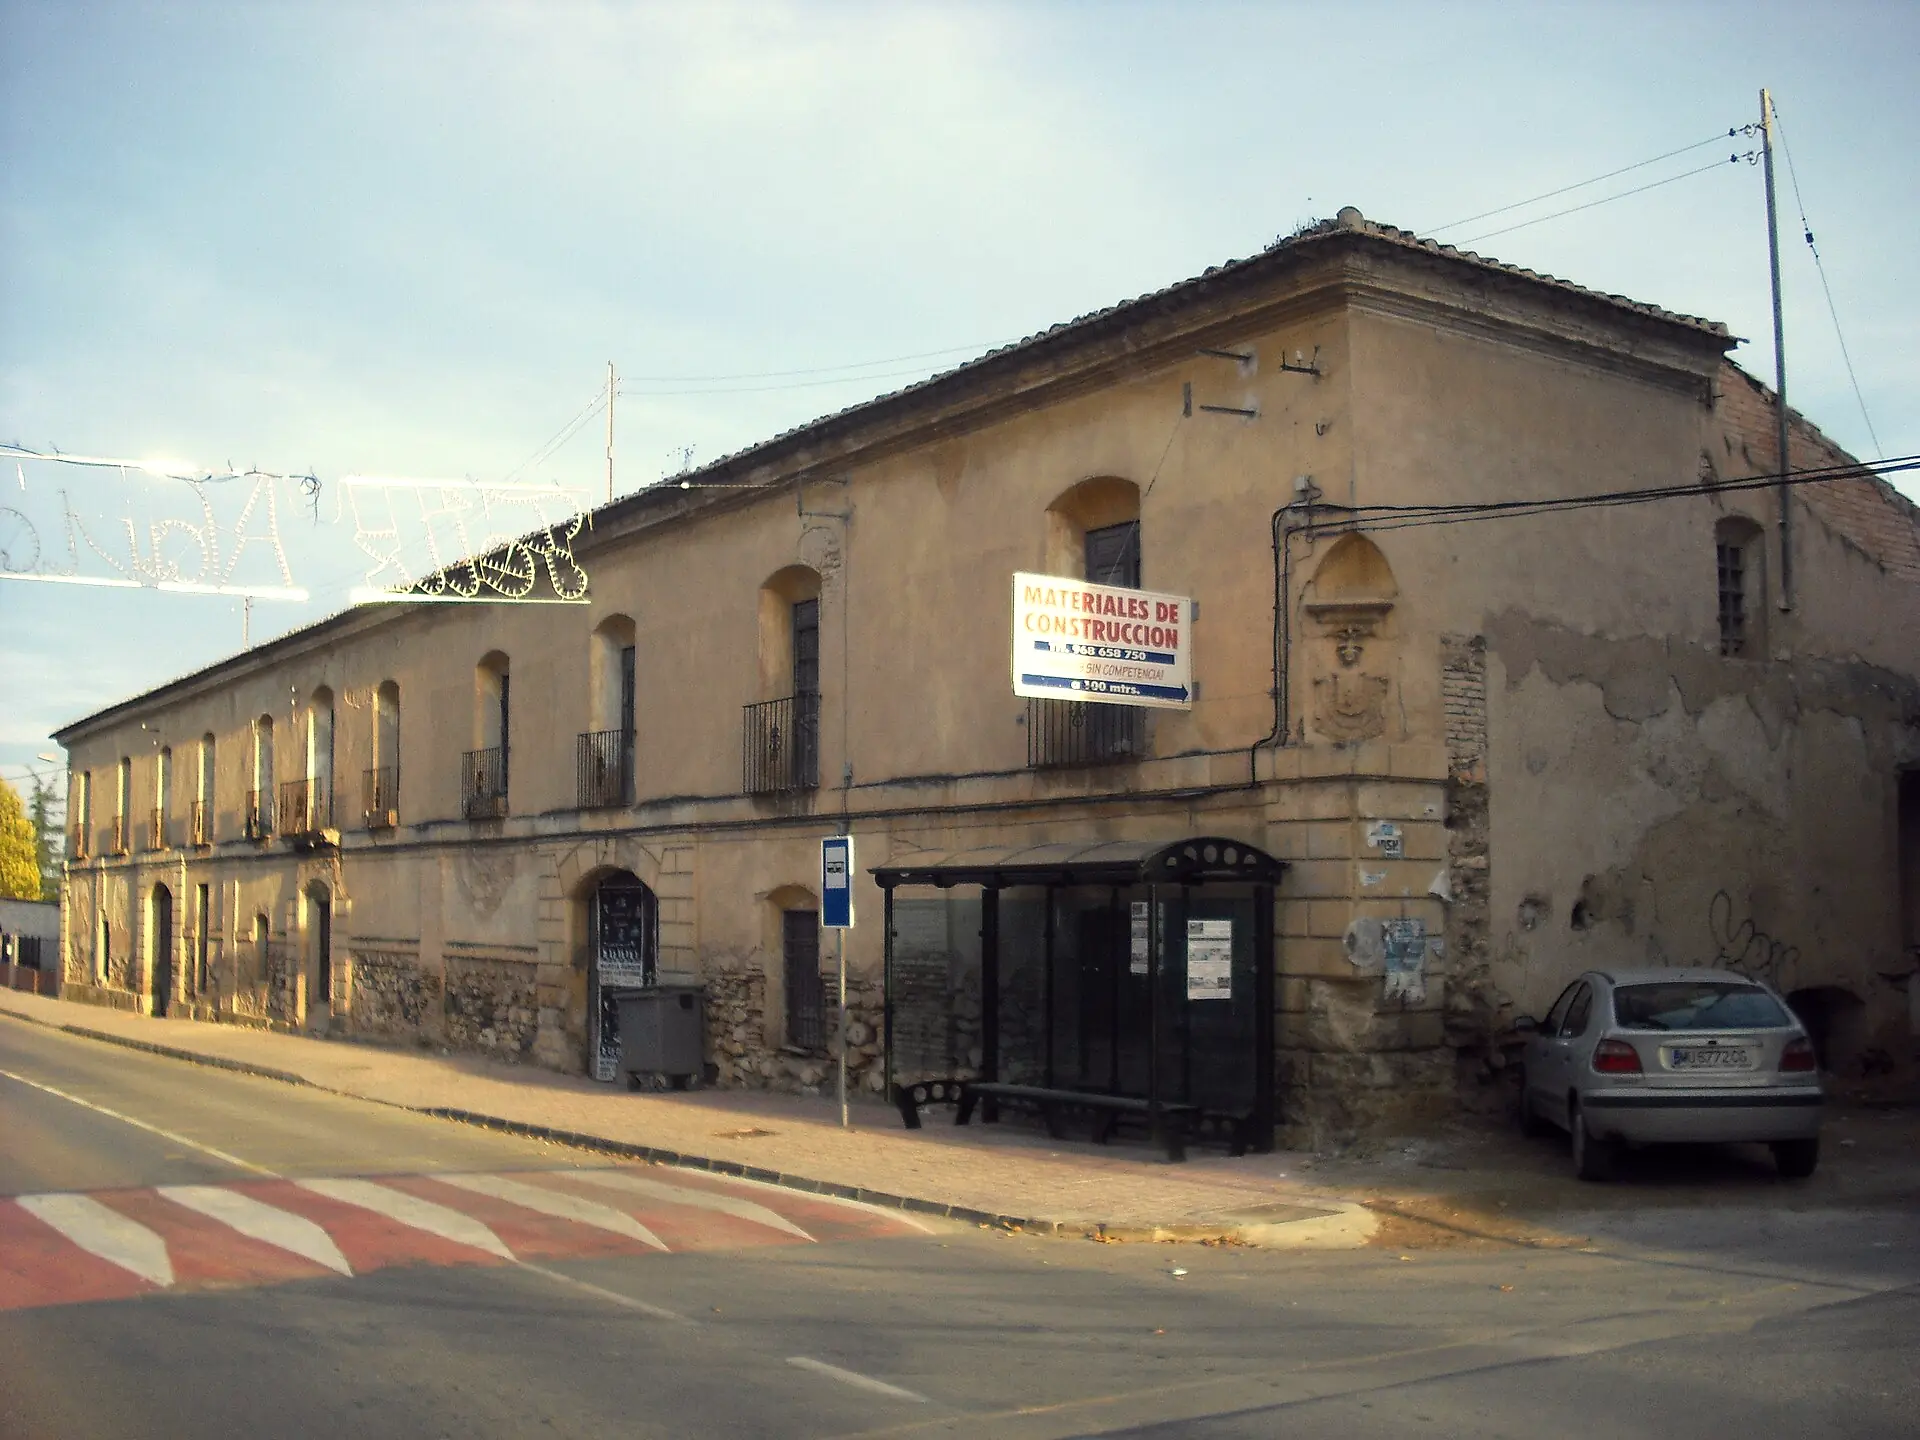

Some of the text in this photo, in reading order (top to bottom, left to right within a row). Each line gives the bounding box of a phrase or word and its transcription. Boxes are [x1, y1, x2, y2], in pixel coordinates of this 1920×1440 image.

[1024, 585, 1179, 624] MATERIALES DE
[1025, 612, 1178, 650] CONSTRUCCION
[1072, 645, 1096, 656] 968
[1099, 647, 1122, 658] 658
[1124, 649, 1147, 660] 750
[1086, 663, 1101, 674] SIN
